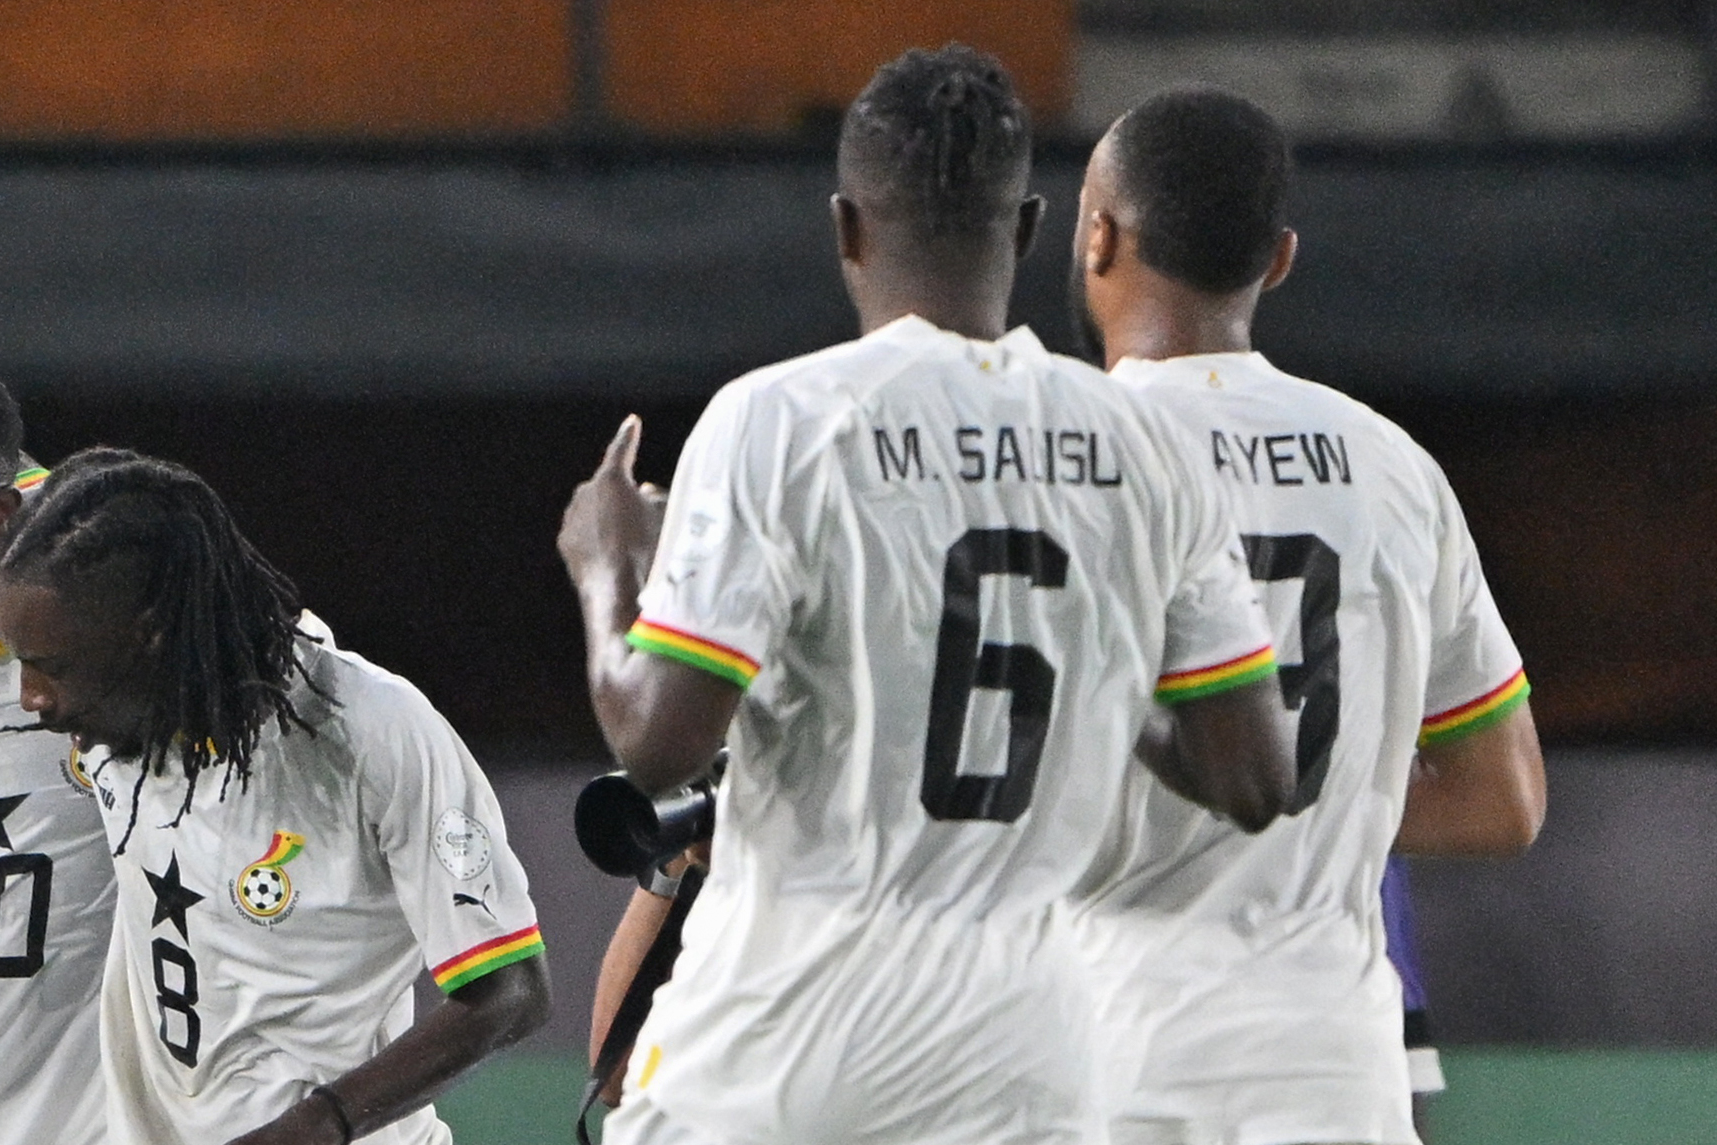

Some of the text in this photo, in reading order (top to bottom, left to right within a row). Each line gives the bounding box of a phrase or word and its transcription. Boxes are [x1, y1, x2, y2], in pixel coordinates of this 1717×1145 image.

[874, 427, 940, 482] M.
[1211, 429, 1352, 485] AYEW
[920, 529, 1069, 823] 6
[151, 937, 200, 1069] 8
